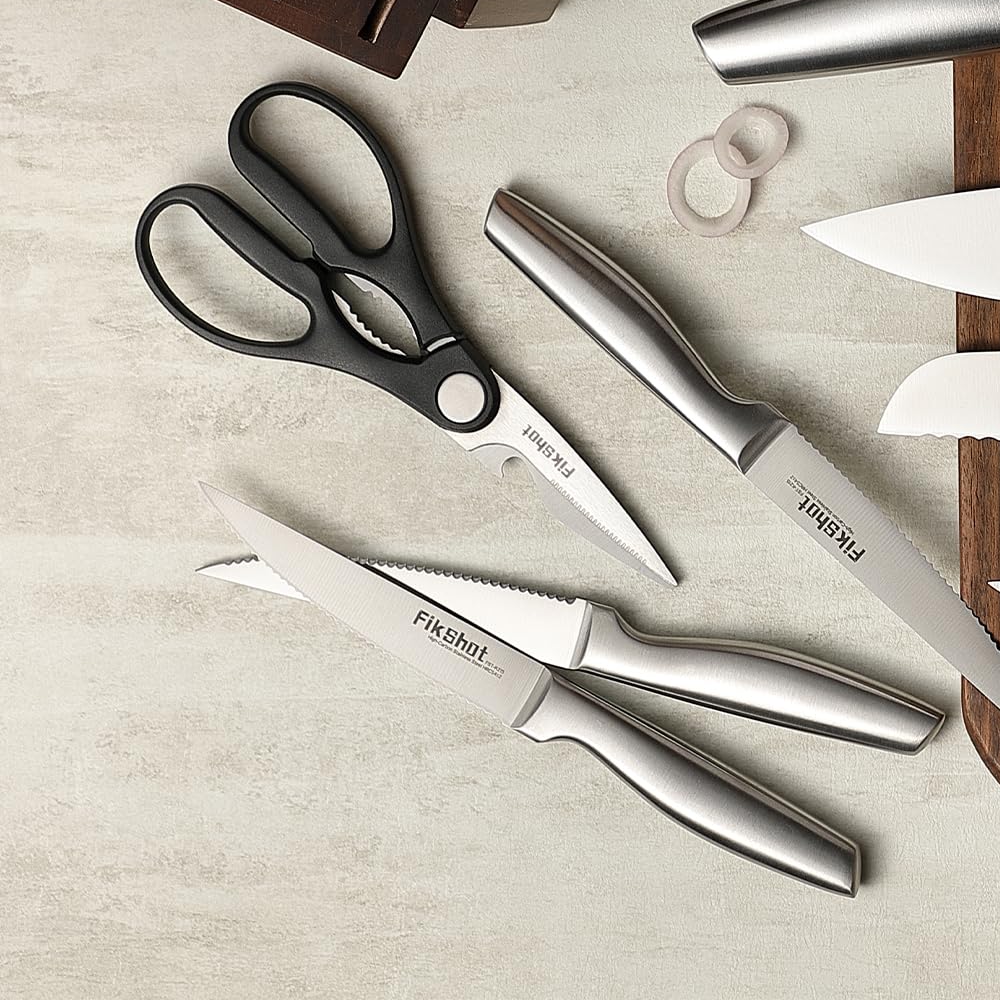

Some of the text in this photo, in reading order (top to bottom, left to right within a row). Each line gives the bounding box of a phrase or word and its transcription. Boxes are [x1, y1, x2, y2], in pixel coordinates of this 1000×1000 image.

[521, 423, 575, 478] FikShot
[797, 494, 866, 562] FikShot
[412, 609, 488, 662] FikShot
